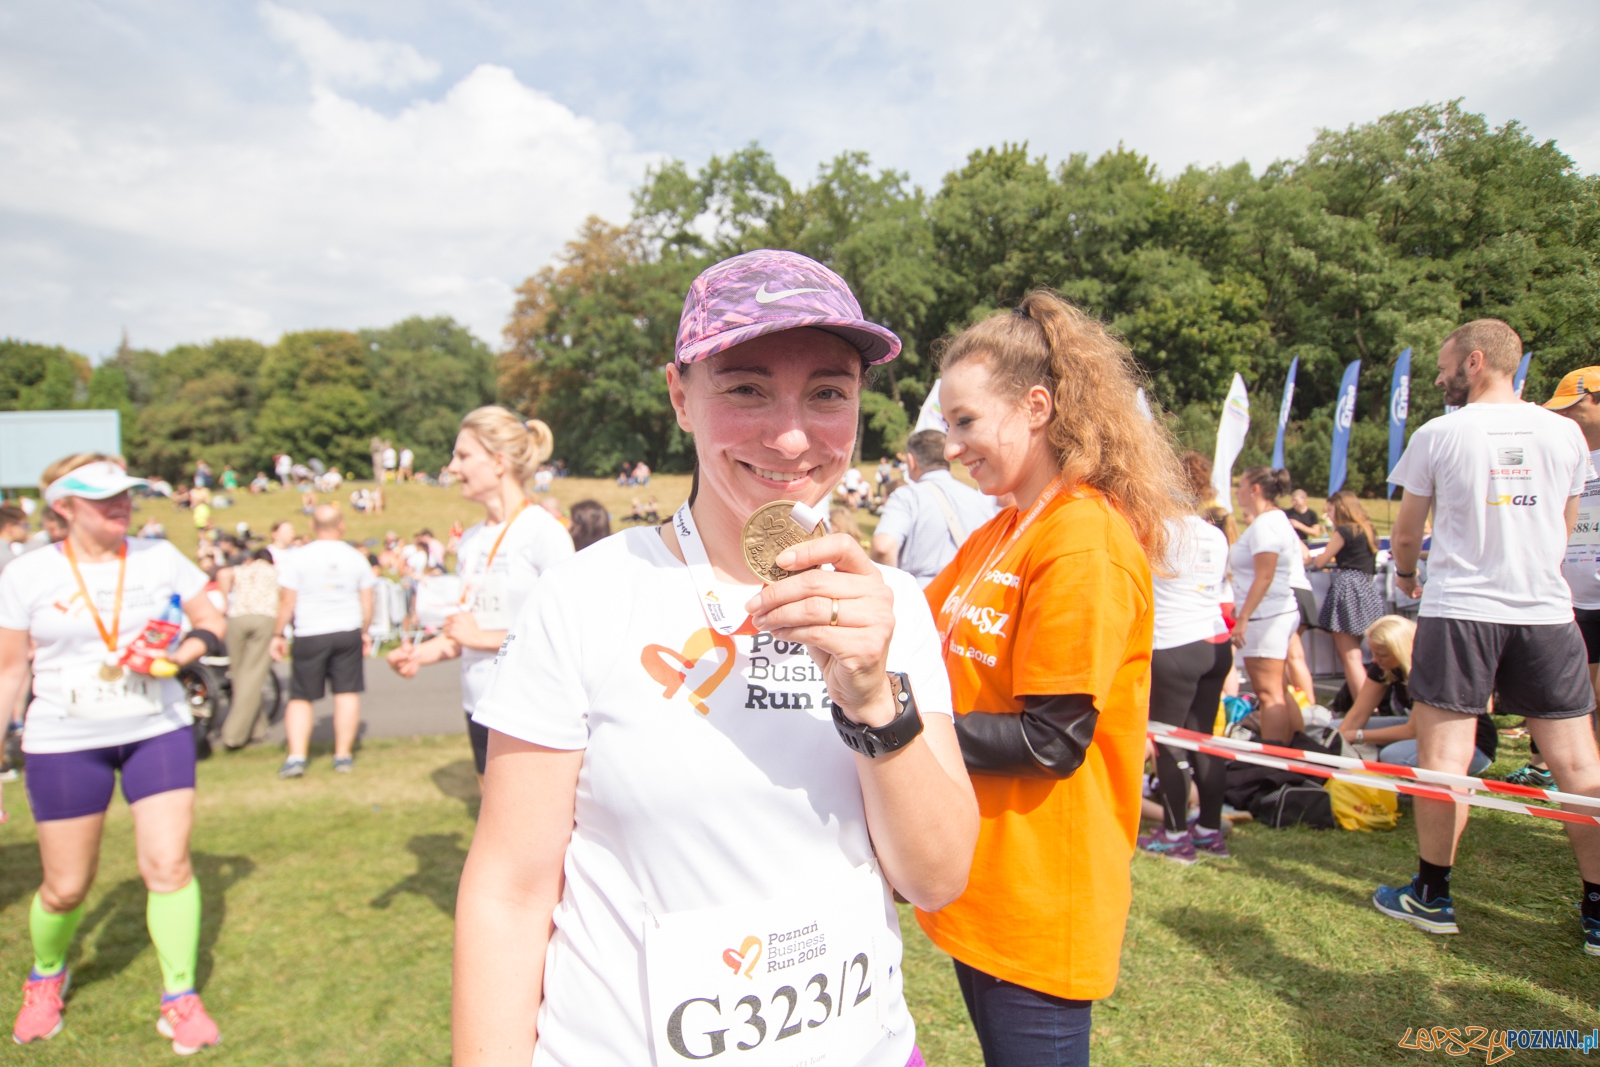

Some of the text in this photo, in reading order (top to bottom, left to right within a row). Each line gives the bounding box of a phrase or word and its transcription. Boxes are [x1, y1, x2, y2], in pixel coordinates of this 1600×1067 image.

[1341, 385, 1355, 428] Enea
[1397, 375, 1409, 419] Enea
[1512, 495, 1537, 506] GLS
[750, 632, 808, 656] Poz
[966, 647, 997, 667] 2016
[748, 656, 825, 682] Busi
[745, 684, 813, 710] Run
[768, 920, 818, 945] Poznań
[767, 934, 825, 959] Business
[767, 944, 827, 973] Run 2016
[667, 952, 872, 1061] G323/2
